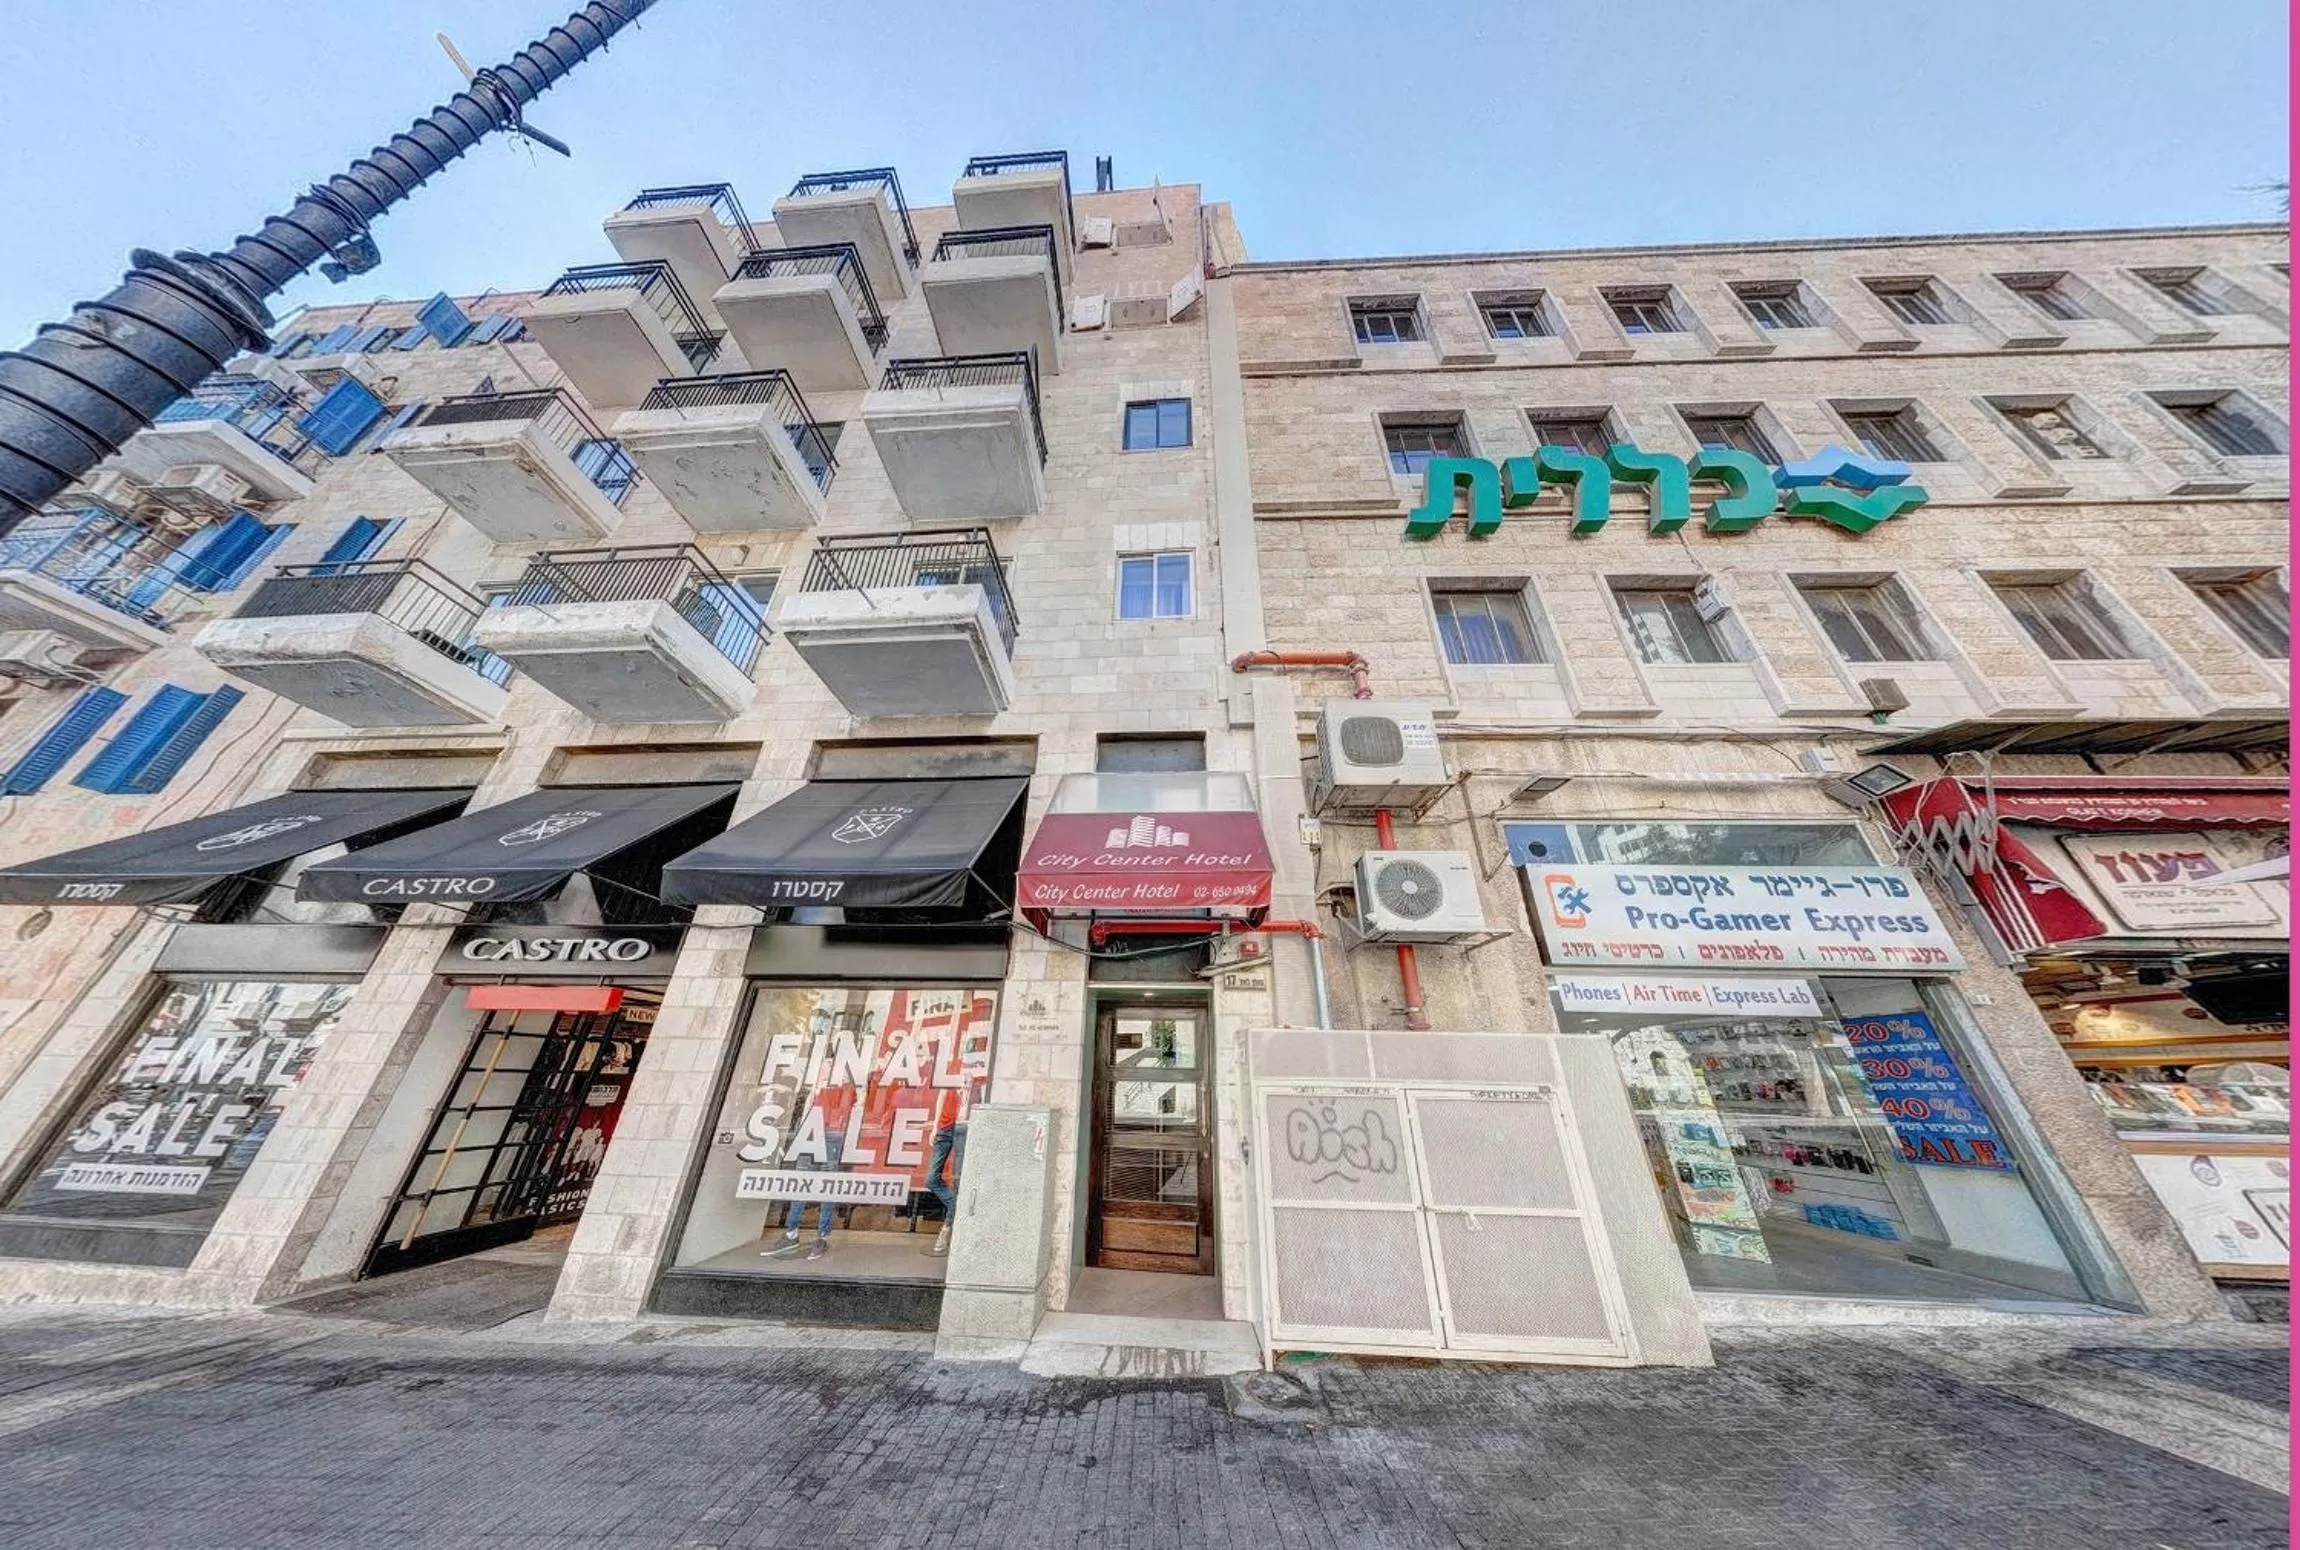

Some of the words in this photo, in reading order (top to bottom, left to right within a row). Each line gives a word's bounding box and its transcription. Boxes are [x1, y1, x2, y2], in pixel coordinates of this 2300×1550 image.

[1405, 443, 1780, 536] כללית
[1037, 853, 1088, 868] City
[1093, 853, 1179, 866] Center
[1184, 853, 1252, 866] Hotel
[363, 878, 495, 896] CASTRO
[771, 881, 844, 898] קסטרו
[1034, 884, 1070, 904] City
[1073, 884, 1129, 900] Center
[1132, 884, 1179, 899] Hotel
[1614, 873, 1735, 903] אקספרס
[1625, 906, 1792, 931] Pro-Gamer
[1804, 907, 1930, 941] Express
[463, 937, 649, 962] CASTRO
[1561, 942, 1598, 958] חיוג
[1602, 942, 1665, 959] כרטיסי
[1698, 939, 1784, 961] פלאפונים
[1817, 945, 1877, 962] מהירה
[1881, 945, 1950, 964] מעבדת
[1562, 983, 1622, 1002] Phones
[1633, 985, 1657, 1002] Air
[1659, 985, 1703, 1003] Time
[1712, 987, 1777, 1009] Express
[1780, 986, 1811, 1005] Lab
[1844, 1019, 1927, 1042] 20%
[121, 1034, 303, 1088] FINAL
[760, 1030, 966, 1088] FINAL
[1862, 1057, 1950, 1080] 30%
[1881, 1097, 1972, 1121] 40%
[72, 1101, 251, 1157] SALE
[737, 1104, 930, 1167] SALE
[1899, 1135, 2006, 1169] SALE
[64, 1169, 122, 1185] אחרונה
[127, 1169, 202, 1187] הזדמנות
[743, 1175, 814, 1193] אחרונה
[529, 1189, 590, 1206] FSHION
[819, 1178, 904, 1197] הזדמנות
